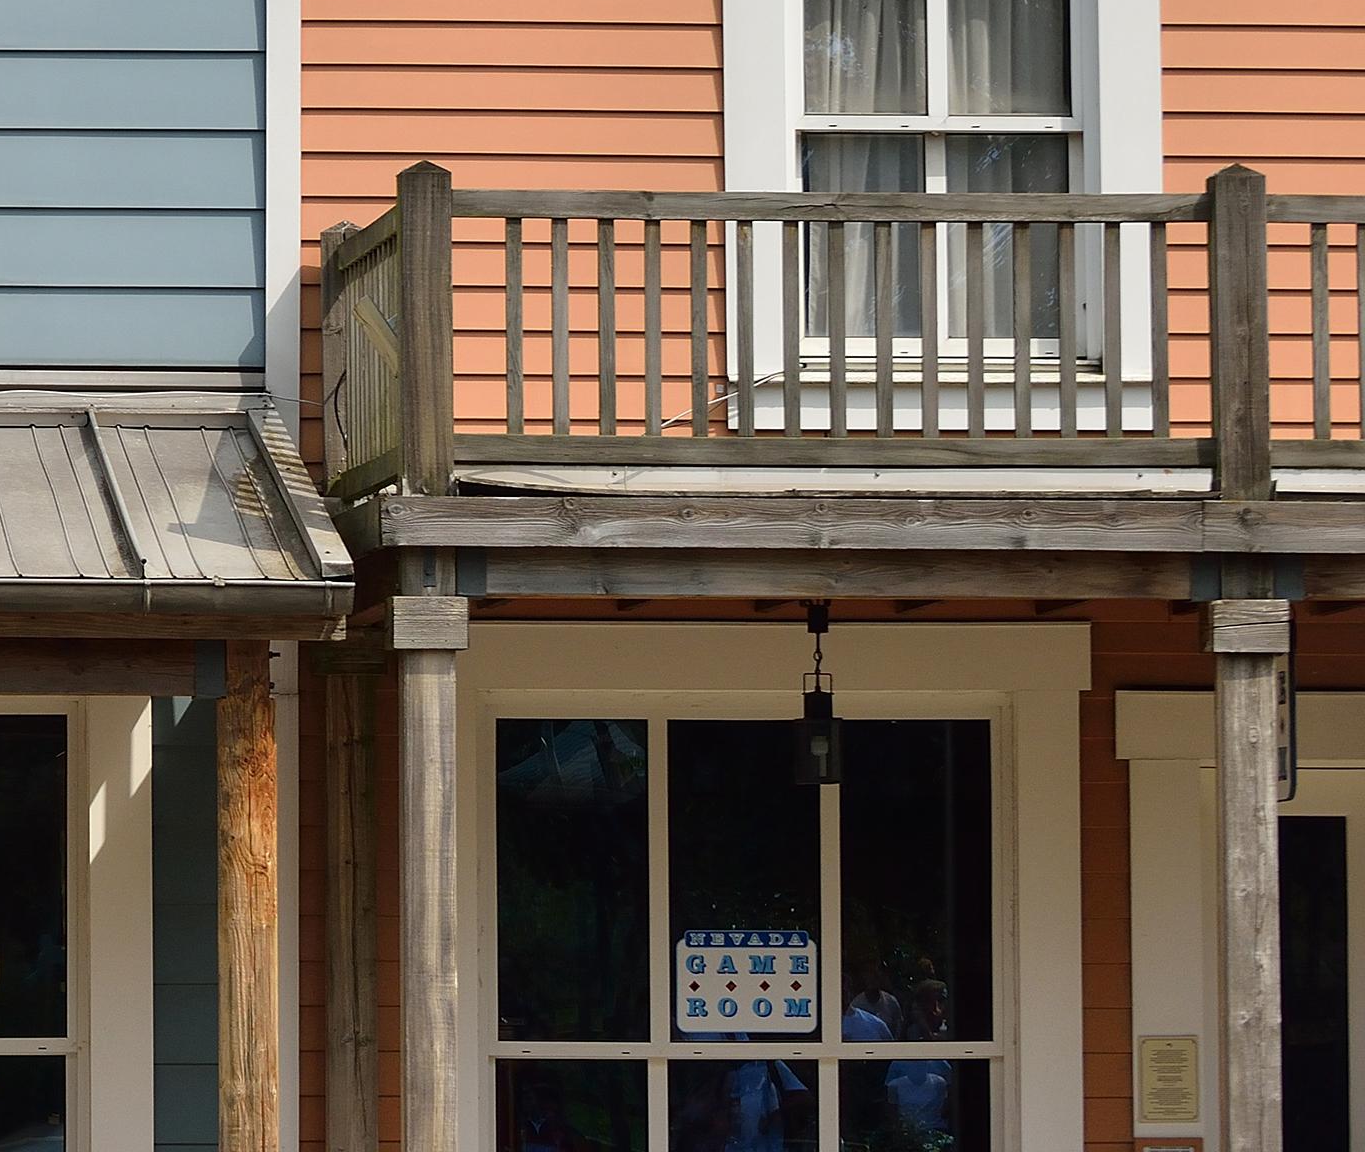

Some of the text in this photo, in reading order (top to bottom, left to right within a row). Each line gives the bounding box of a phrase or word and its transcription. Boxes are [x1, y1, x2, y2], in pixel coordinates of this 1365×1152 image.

[689, 933, 804, 946] NEVADA
[685, 954, 810, 974] GAME
[686, 998, 812, 1018] ROOM
